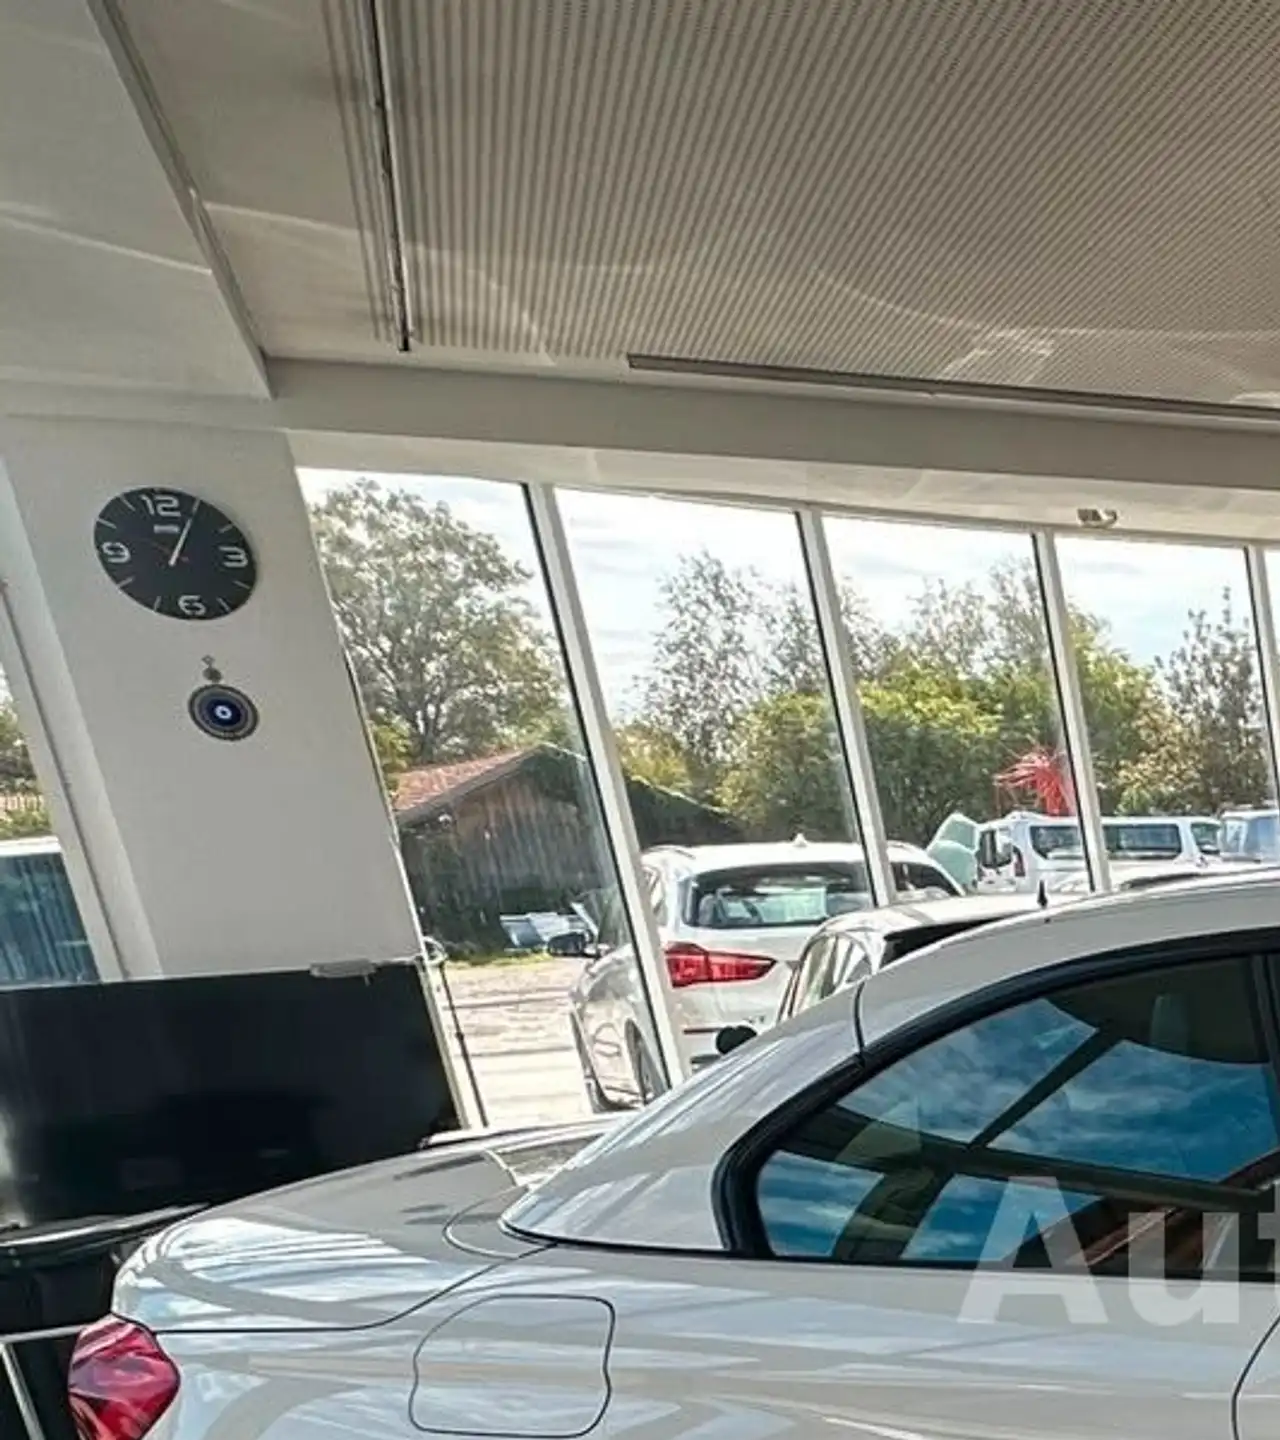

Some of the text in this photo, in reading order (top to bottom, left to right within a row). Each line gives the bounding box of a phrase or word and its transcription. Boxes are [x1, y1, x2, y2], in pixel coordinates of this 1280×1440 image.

[140, 494, 181, 517] 12
[102, 542, 131, 563] 9
[219, 546, 248, 567] 3
[178, 595, 206, 615] 6
